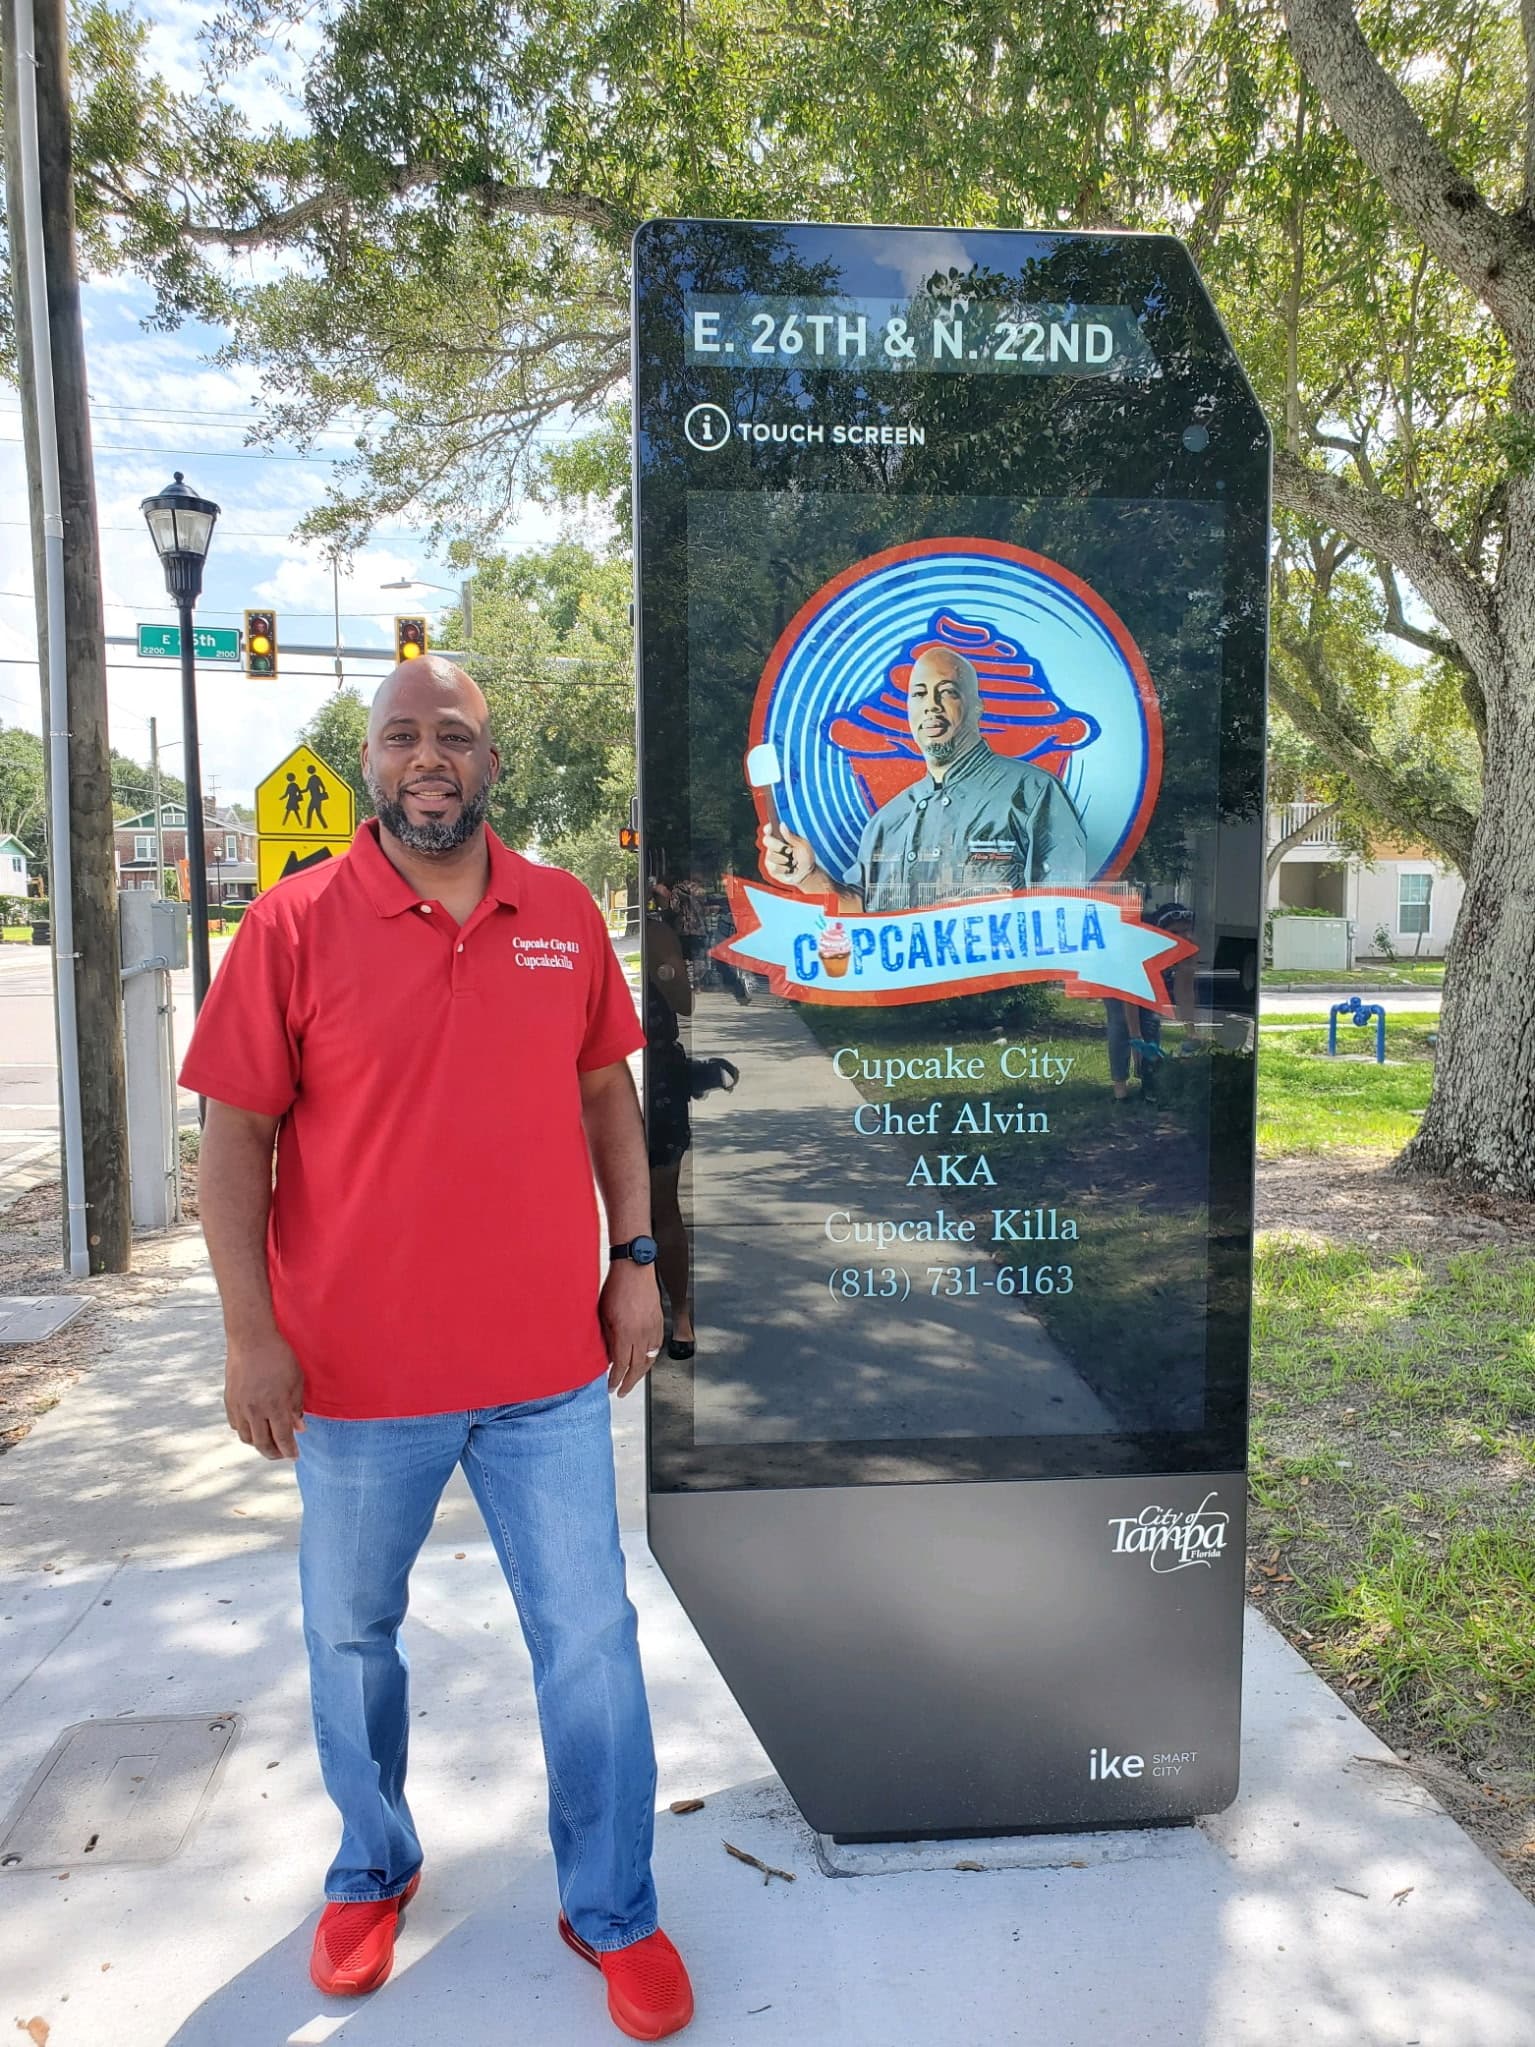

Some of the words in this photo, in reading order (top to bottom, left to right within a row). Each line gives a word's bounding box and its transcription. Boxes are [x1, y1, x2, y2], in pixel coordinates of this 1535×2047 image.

[693, 311, 734, 353] E.
[751, 313, 867, 357] 26TH
[884, 317, 917, 359] &
[933, 319, 978, 361] N.
[993, 320, 1114, 365] 22ND
[739, 421, 824, 444] TOUCH
[832, 424, 926, 446] SCREEN
[143, 647, 165, 655] 2200
[162, 634, 171, 645] E
[512, 936, 550, 951] Cupcake
[550, 938, 567, 953] City
[793, 902, 1107, 981] CPCAKEKILLA
[514, 953, 574, 970] Cupcakekilla
[832, 1047, 985, 1087] Cupcake
[1000, 1047, 1075, 1085] City
[853, 1102, 942, 1135] Chef
[951, 1101, 1050, 1134] Alvin
[906, 1154, 998, 1187] AKA
[824, 1209, 976, 1250] Cupcake
[990, 1208, 1080, 1241] Killa
[828, 1266, 912, 1303] (813)
[926, 1265, 1074, 1296] 731-6163
[1108, 1518, 1228, 1563] Tampa
[1191, 1549, 1221, 1559] Florida
[1090, 1748, 1145, 1780] ike
[1152, 1752, 1198, 1764] SMART
[1152, 1766, 1182, 1777] CITY
